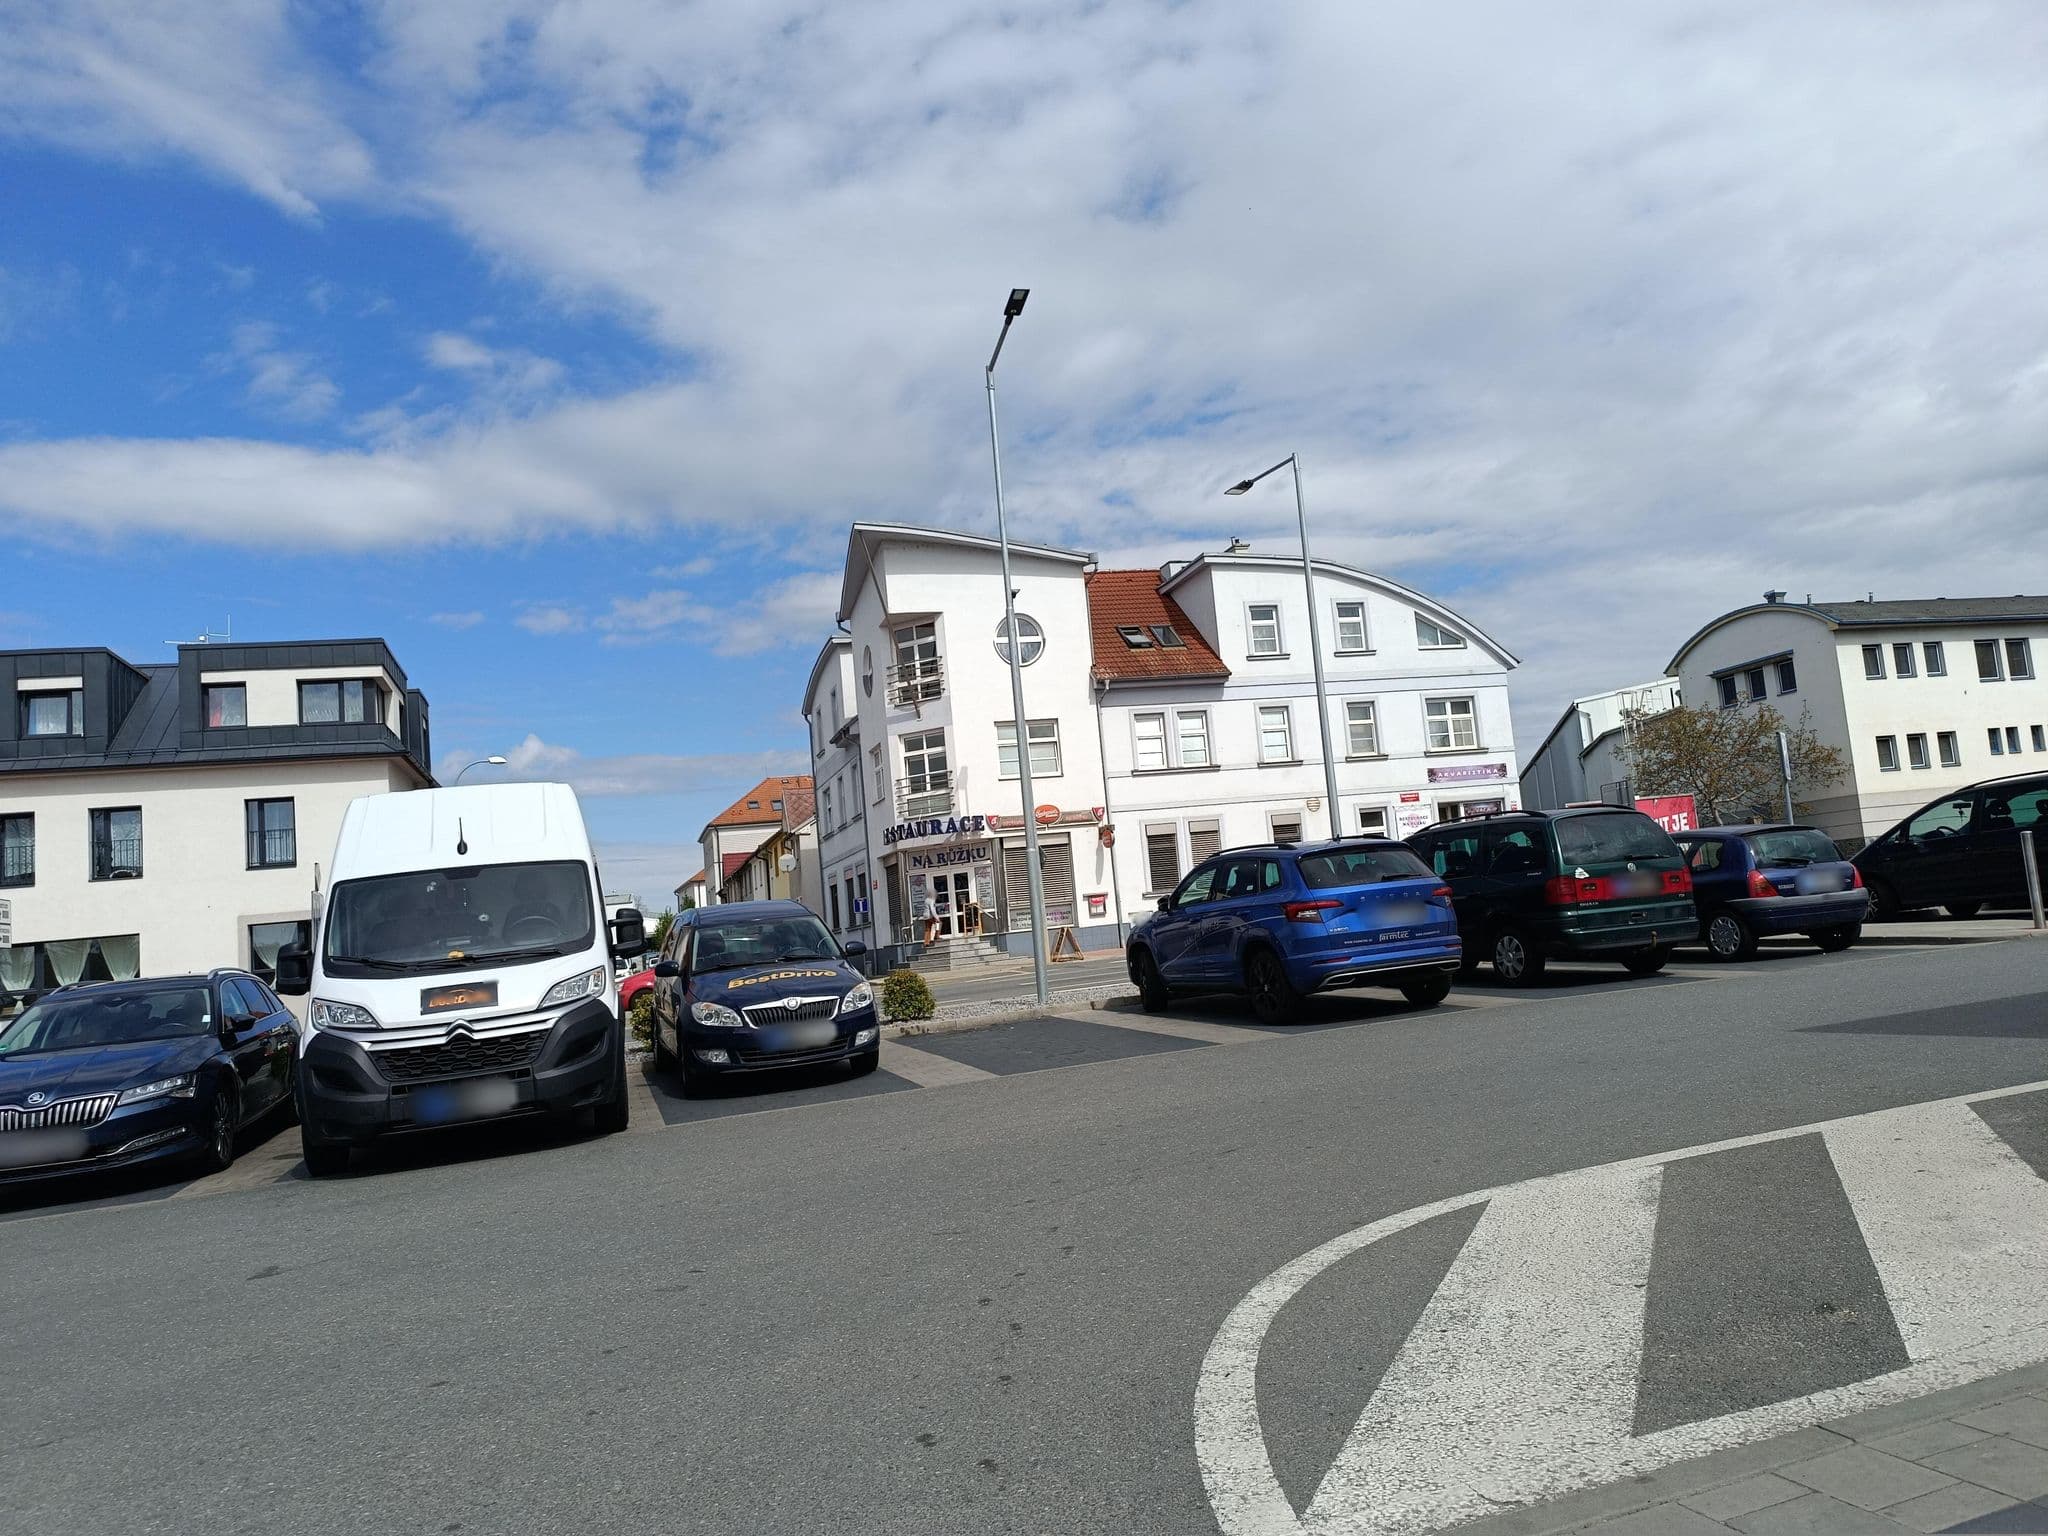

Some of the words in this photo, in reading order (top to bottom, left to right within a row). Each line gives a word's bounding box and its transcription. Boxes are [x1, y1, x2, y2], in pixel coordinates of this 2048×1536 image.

[1438, 768, 1498, 778] AKVARISTIKA
[1671, 812, 1690, 831] JE
[912, 855, 934, 867] NA
[727, 970, 838, 989] BestDrive
